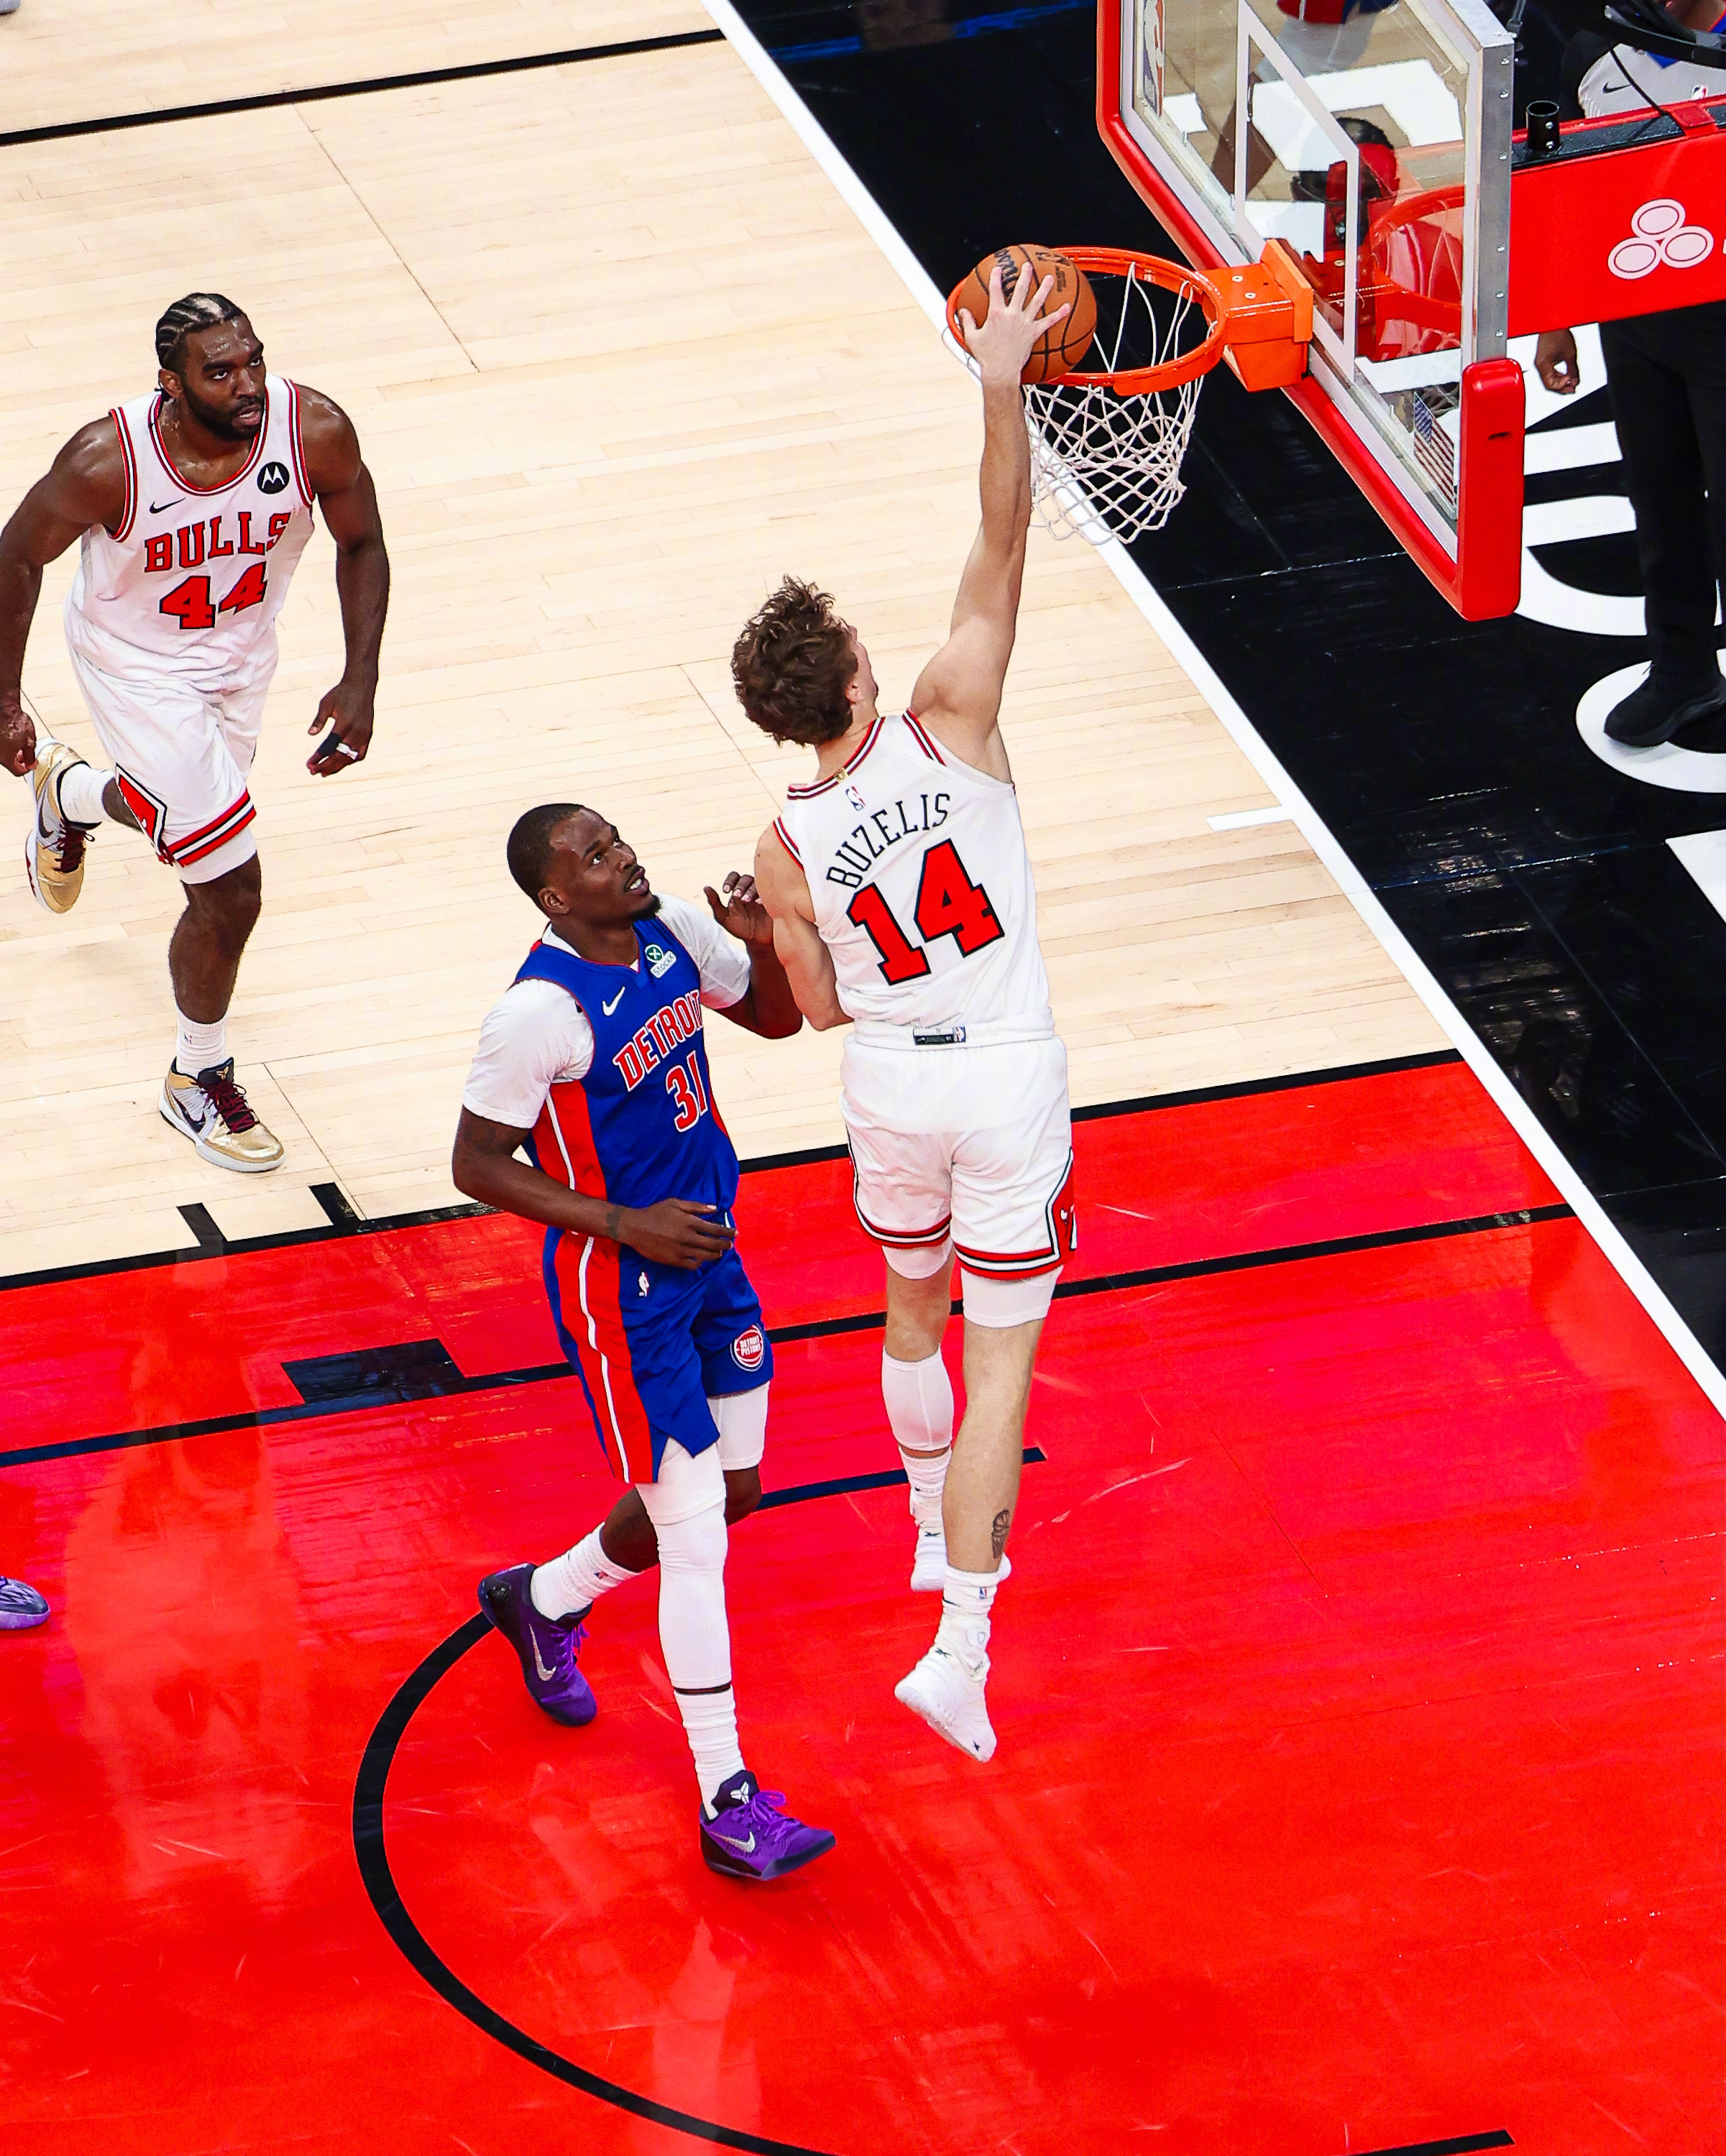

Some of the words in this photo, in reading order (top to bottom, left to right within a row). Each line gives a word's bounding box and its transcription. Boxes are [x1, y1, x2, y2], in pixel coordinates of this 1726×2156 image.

[144, 511, 291, 573] BULLS
[159, 561, 268, 630] 44
[825, 793, 950, 888] BUZELIS
[845, 838, 1005, 986] 14
[612, 989, 703, 1092] DETROIT
[666, 1050, 708, 1133] 31
